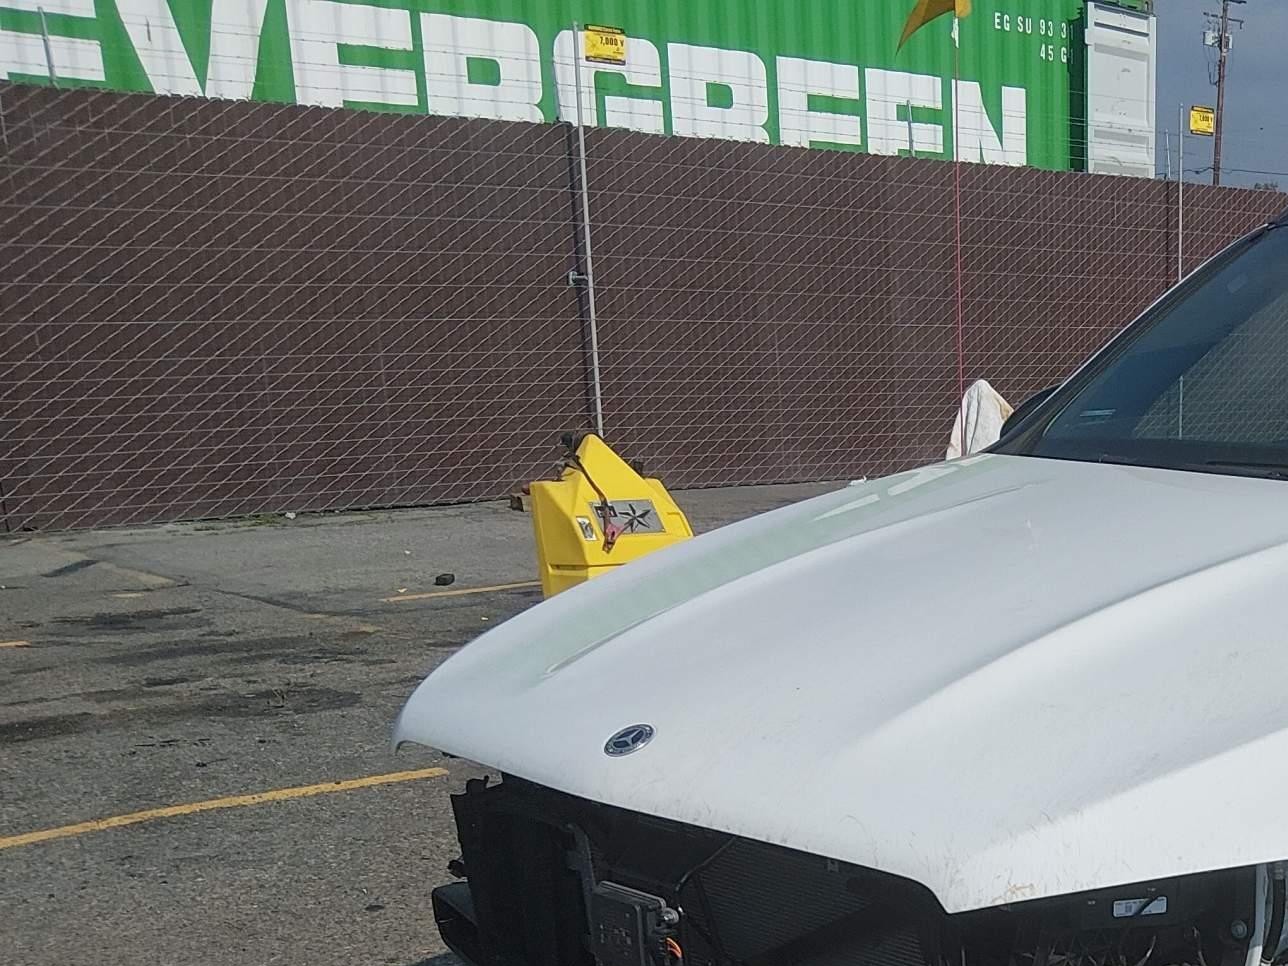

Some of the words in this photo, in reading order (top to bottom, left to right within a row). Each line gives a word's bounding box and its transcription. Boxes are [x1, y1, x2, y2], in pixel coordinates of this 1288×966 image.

[994, 11, 1010, 32] EG
[1017, 15, 1032, 34] SU
[1039, 19, 1054, 37] 93
